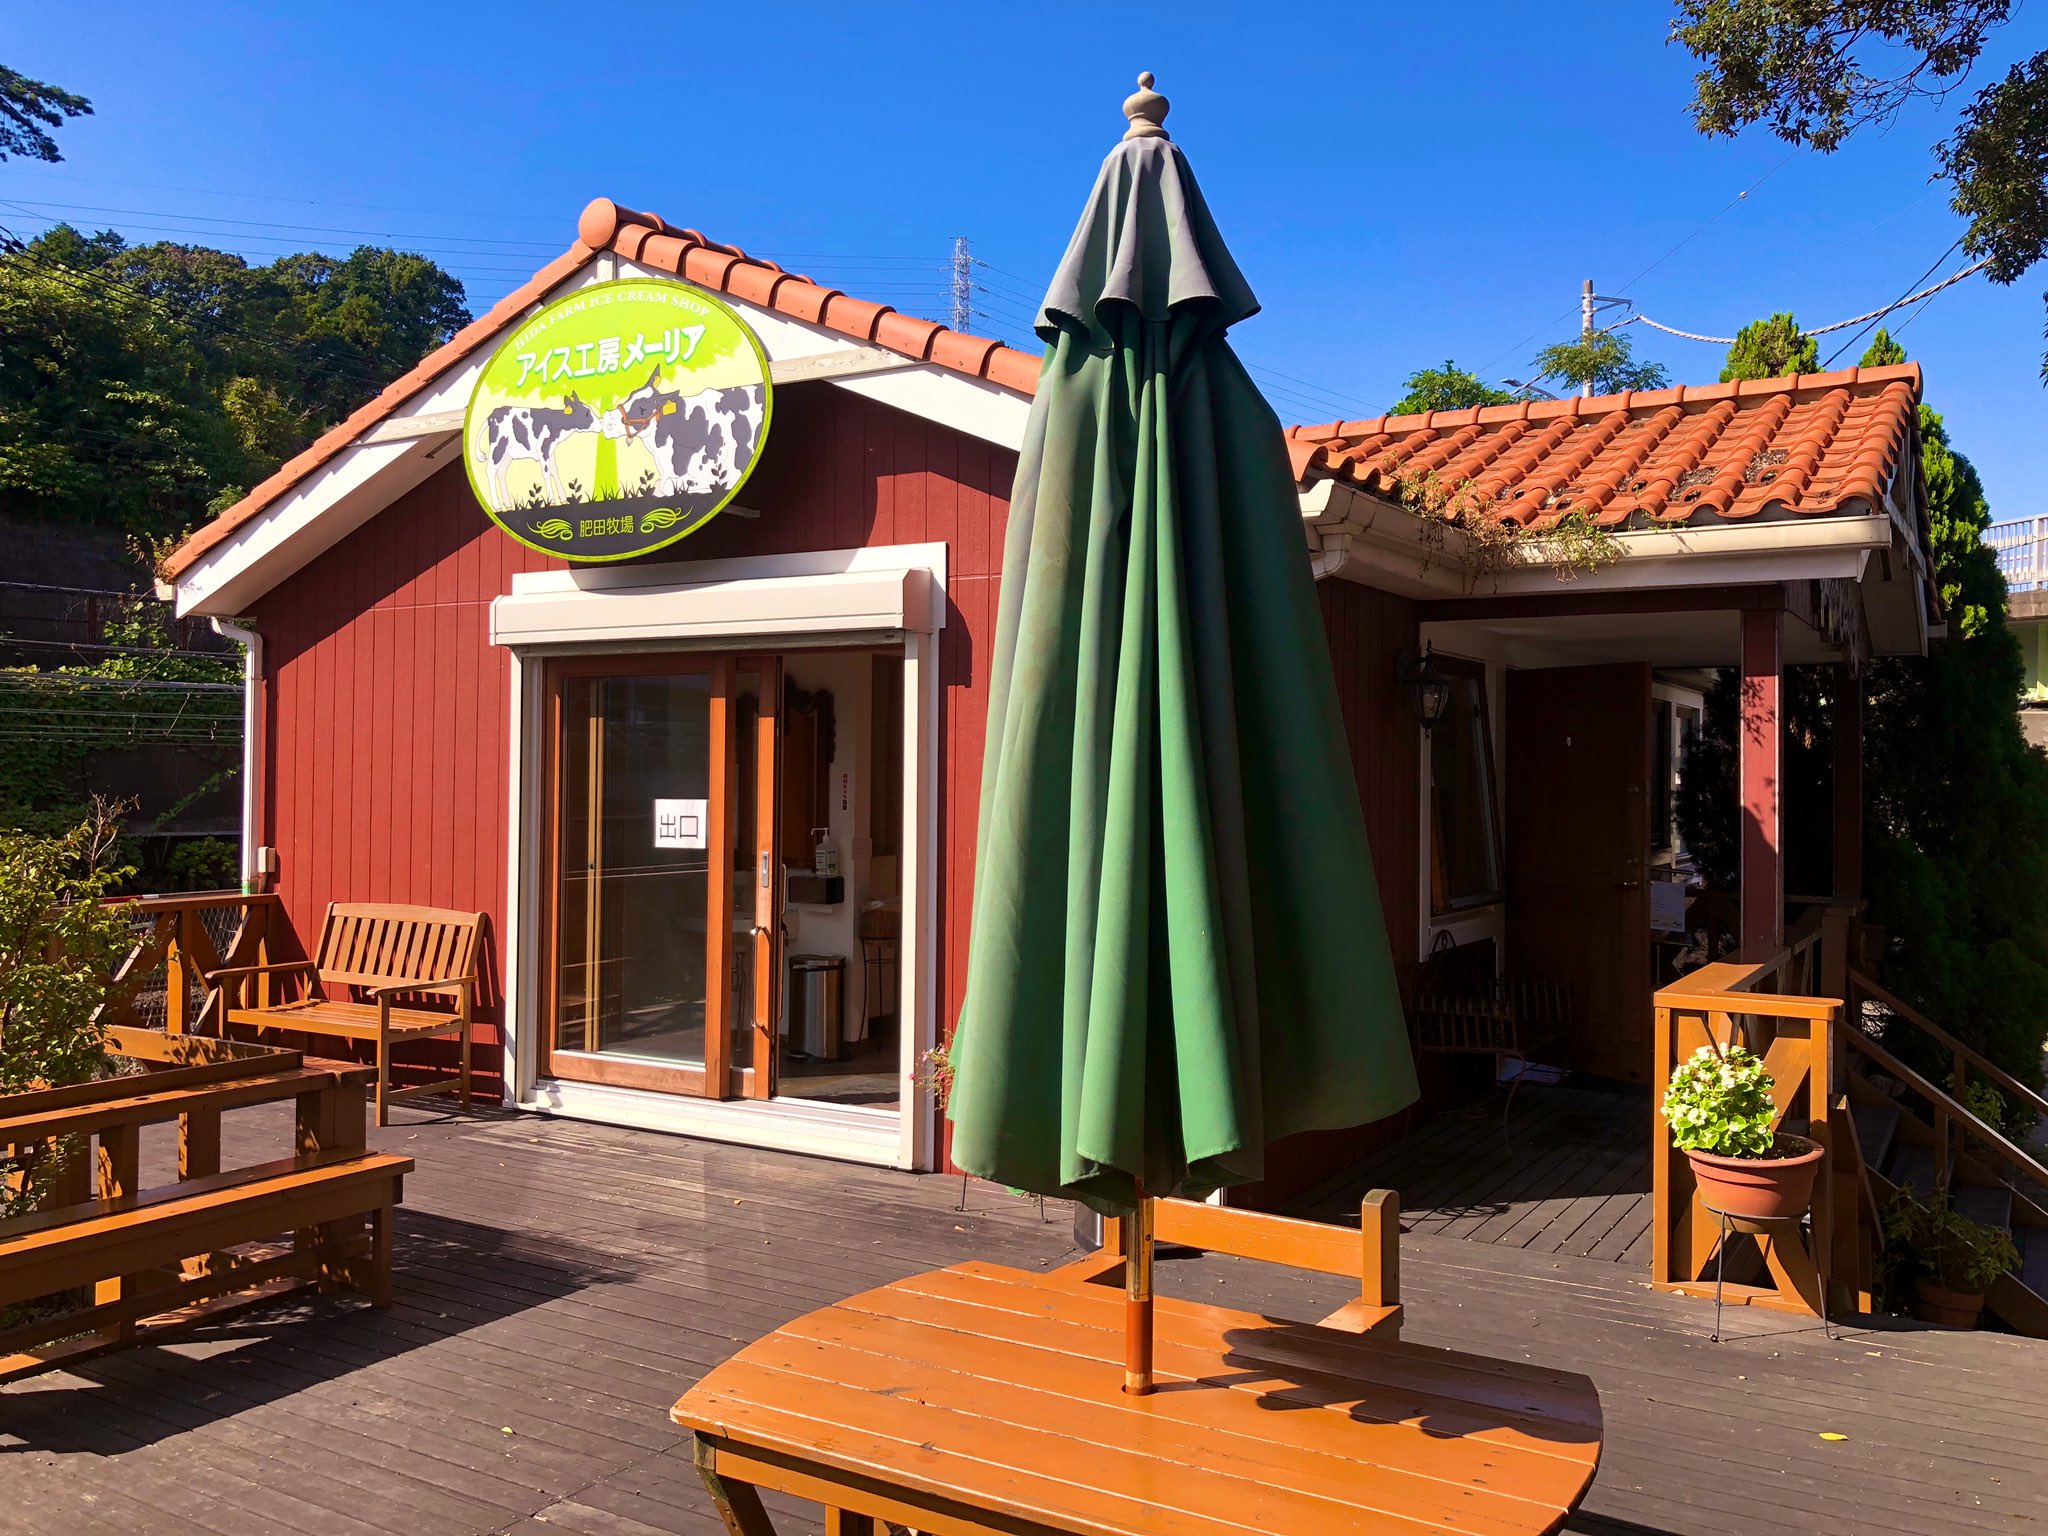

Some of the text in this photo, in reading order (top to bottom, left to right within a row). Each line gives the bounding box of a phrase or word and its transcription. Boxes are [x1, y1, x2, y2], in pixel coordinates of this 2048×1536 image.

[515, 290, 710, 351] HIDA FARM ICE CREAM SHOP
[516, 323, 706, 387] アイス工房メーリア
[580, 515, 634, 538] 肥田牧場
[660, 813, 699, 839] 出口
